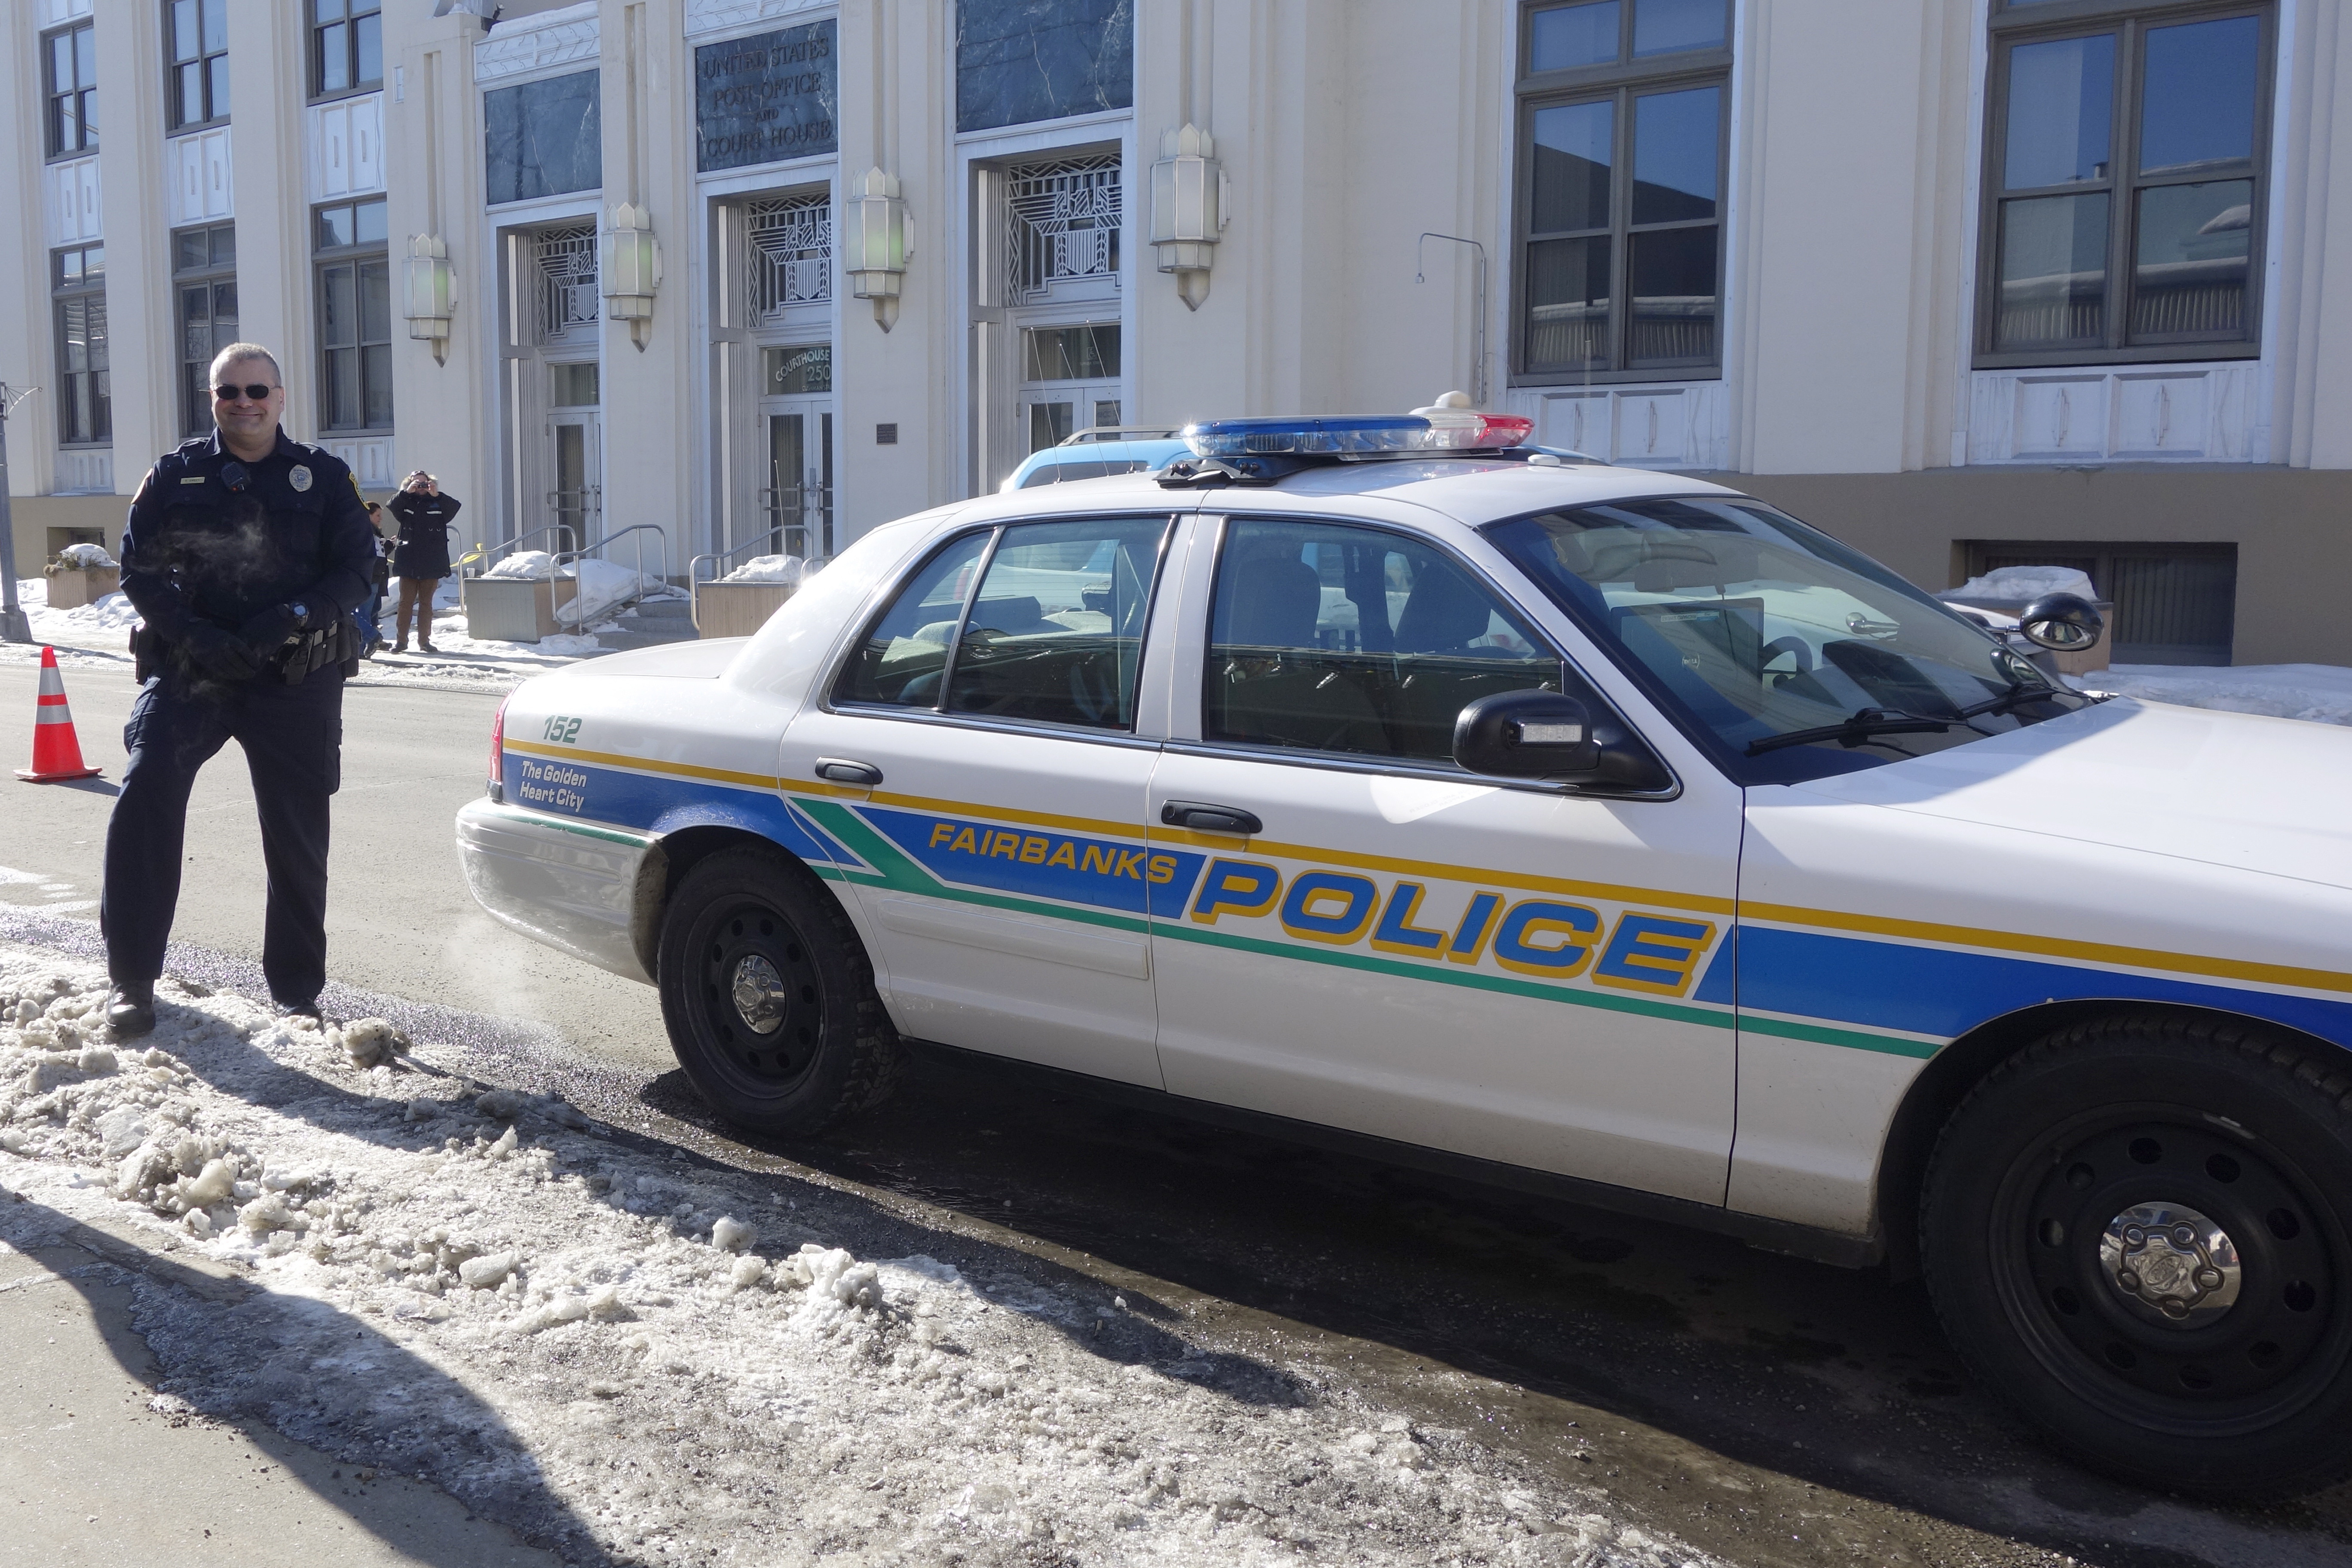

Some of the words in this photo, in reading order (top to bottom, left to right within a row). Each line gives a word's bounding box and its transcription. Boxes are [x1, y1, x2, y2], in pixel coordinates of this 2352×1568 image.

[704, 49, 768, 79] UNITED
[771, 37, 829, 67] STATES
[713, 84, 753, 109] POST
[760, 71, 821, 100] OFFICE
[756, 108, 779, 122] AND
[708, 131, 764, 157] COURT
[769, 119, 832, 147] HOUSE
[775, 349, 830, 382] COURTHOUSE
[807, 364, 831, 382] 250
[543, 715, 582, 744] 152
[521, 761, 542, 780] The
[543, 765, 587, 787] Golden
[519, 781, 555, 803] Heart
[556, 788, 584, 812] City
[929, 823, 1177, 884] FAIRBANKS
[1189, 856, 1717, 998] POLICE
